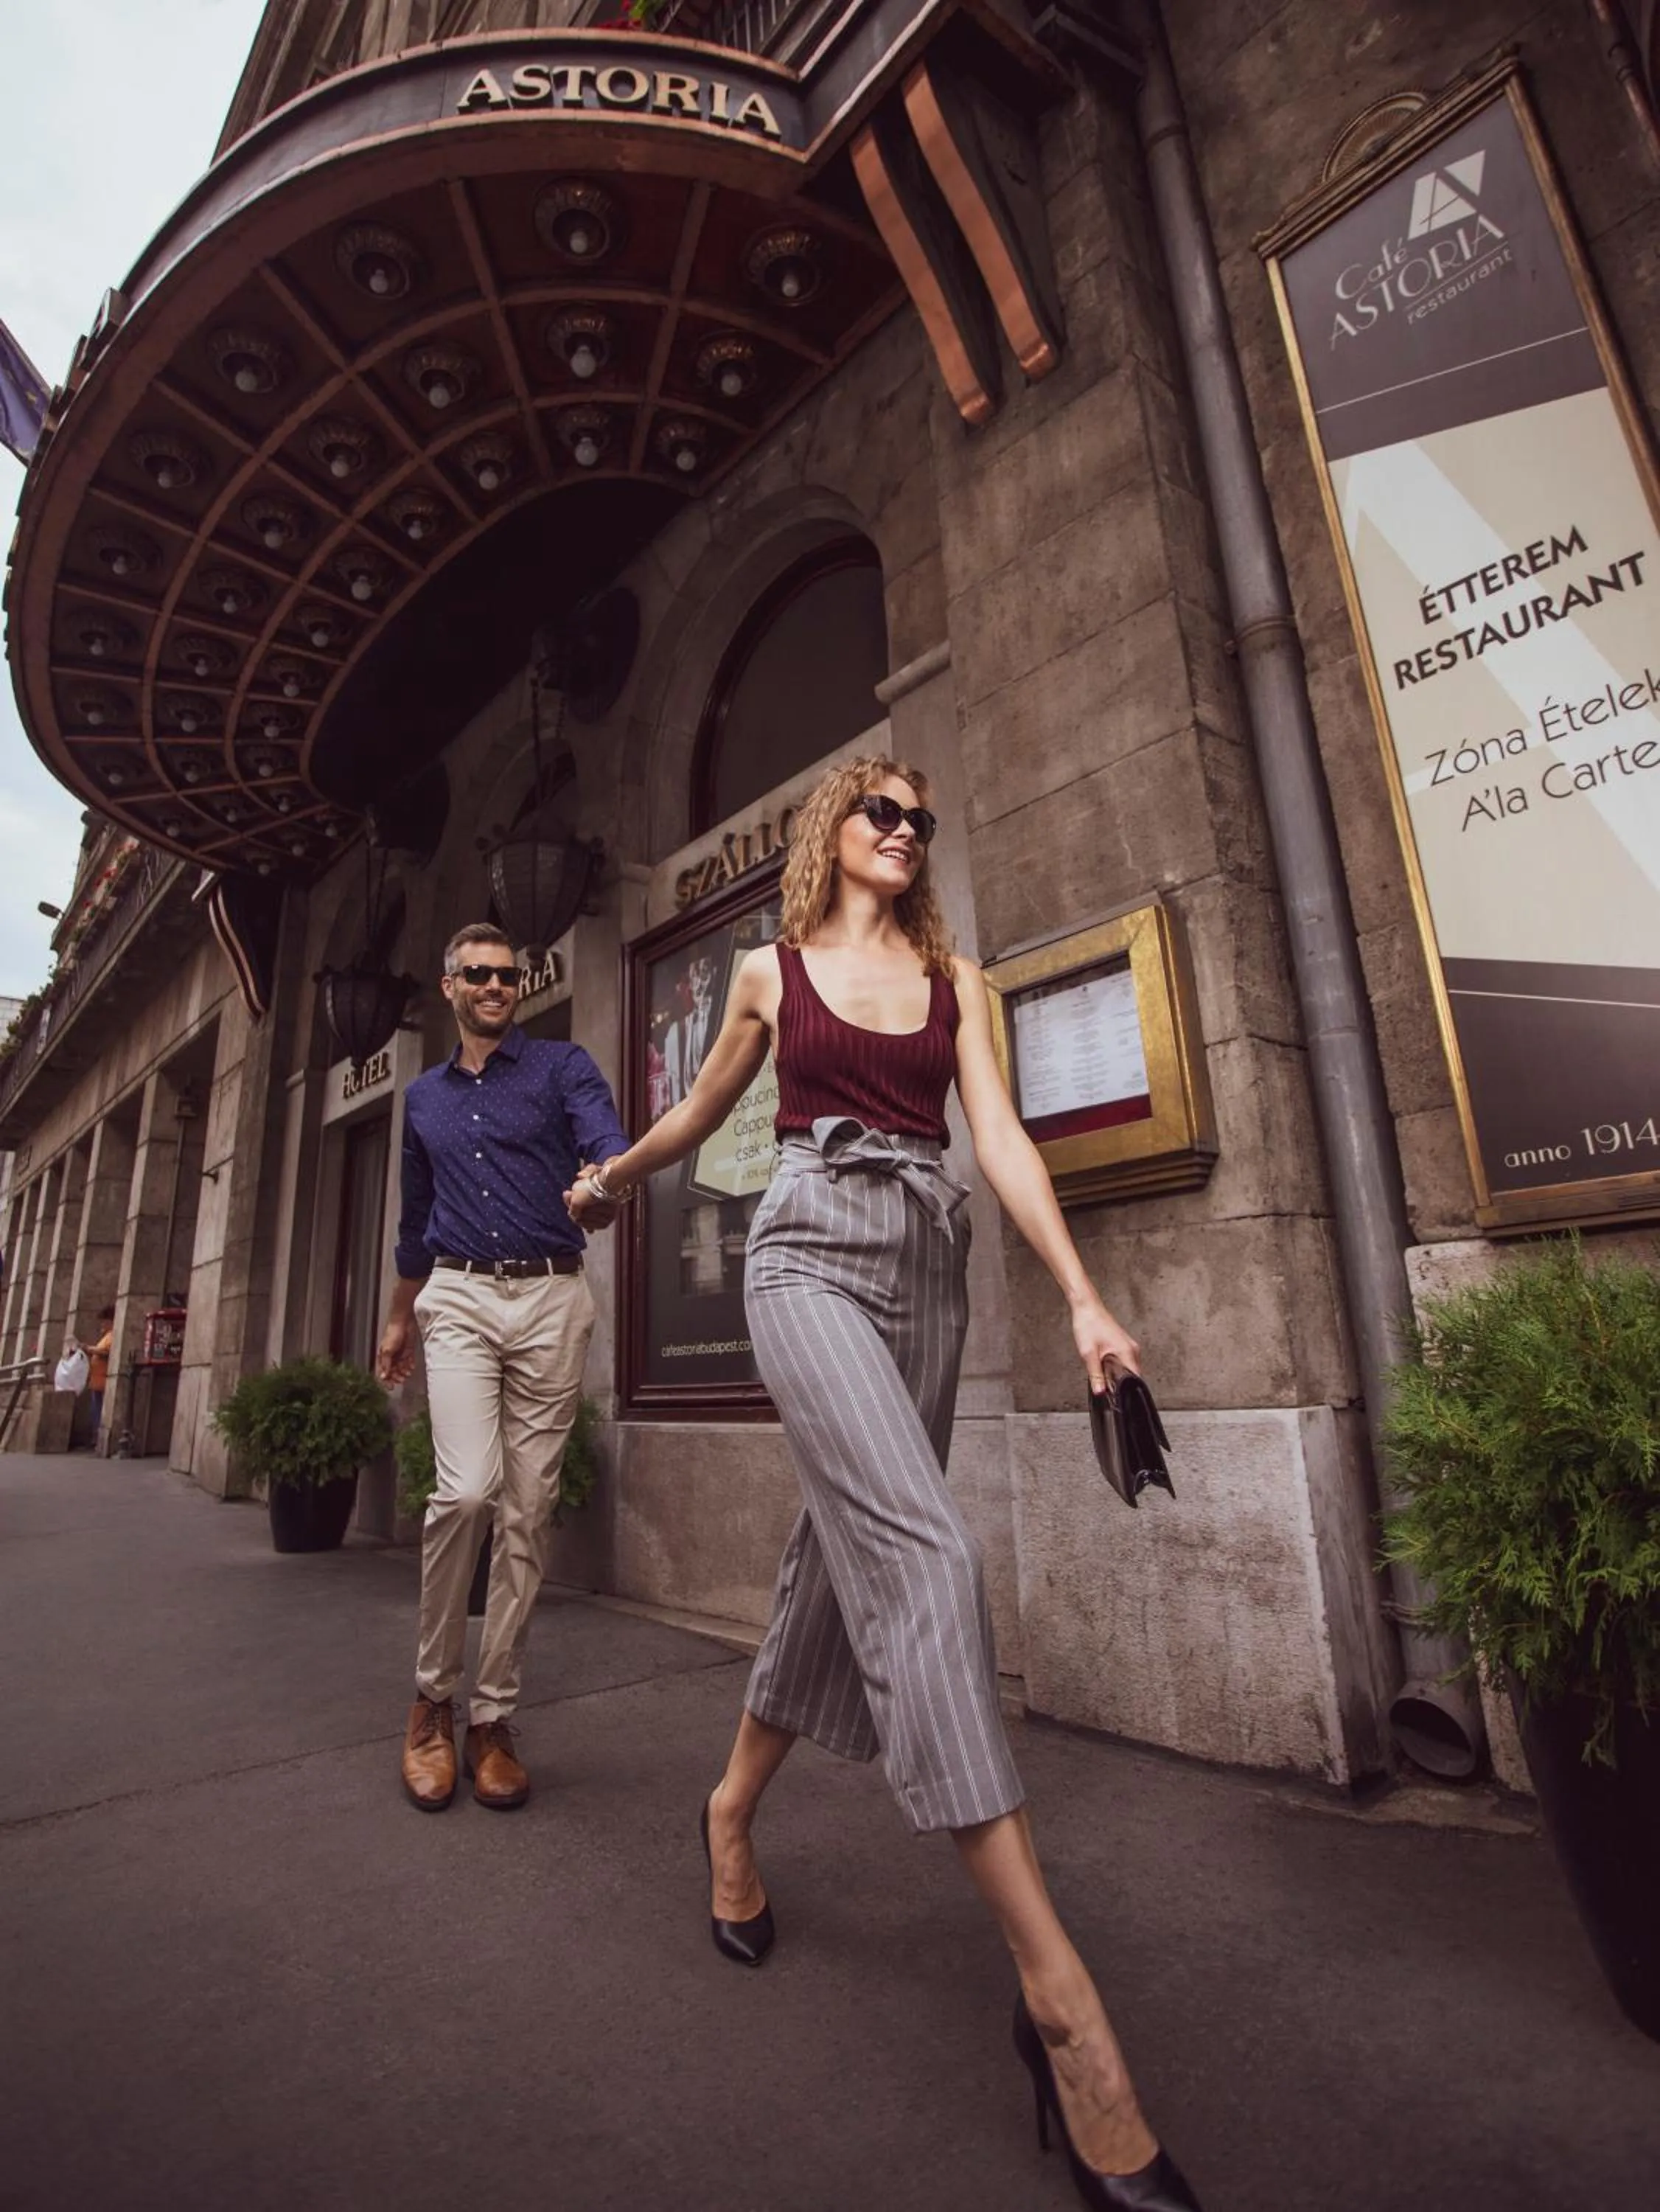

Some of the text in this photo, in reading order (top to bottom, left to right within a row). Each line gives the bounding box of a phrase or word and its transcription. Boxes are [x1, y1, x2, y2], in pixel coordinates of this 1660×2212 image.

[457, 63, 781, 139] ASTORIA
[1329, 214, 1505, 352] ASTORIA
[1335, 237, 1408, 300] Café
[1406, 248, 1513, 325] restaurant
[1418, 524, 1589, 626] ÉTTEREM
[1393, 551, 1645, 690] RESTAURANT
[1424, 728, 1527, 787] Zóna
[1541, 740, 1660, 799] Carte
[1504, 1117, 1660, 1168] anno 1914
